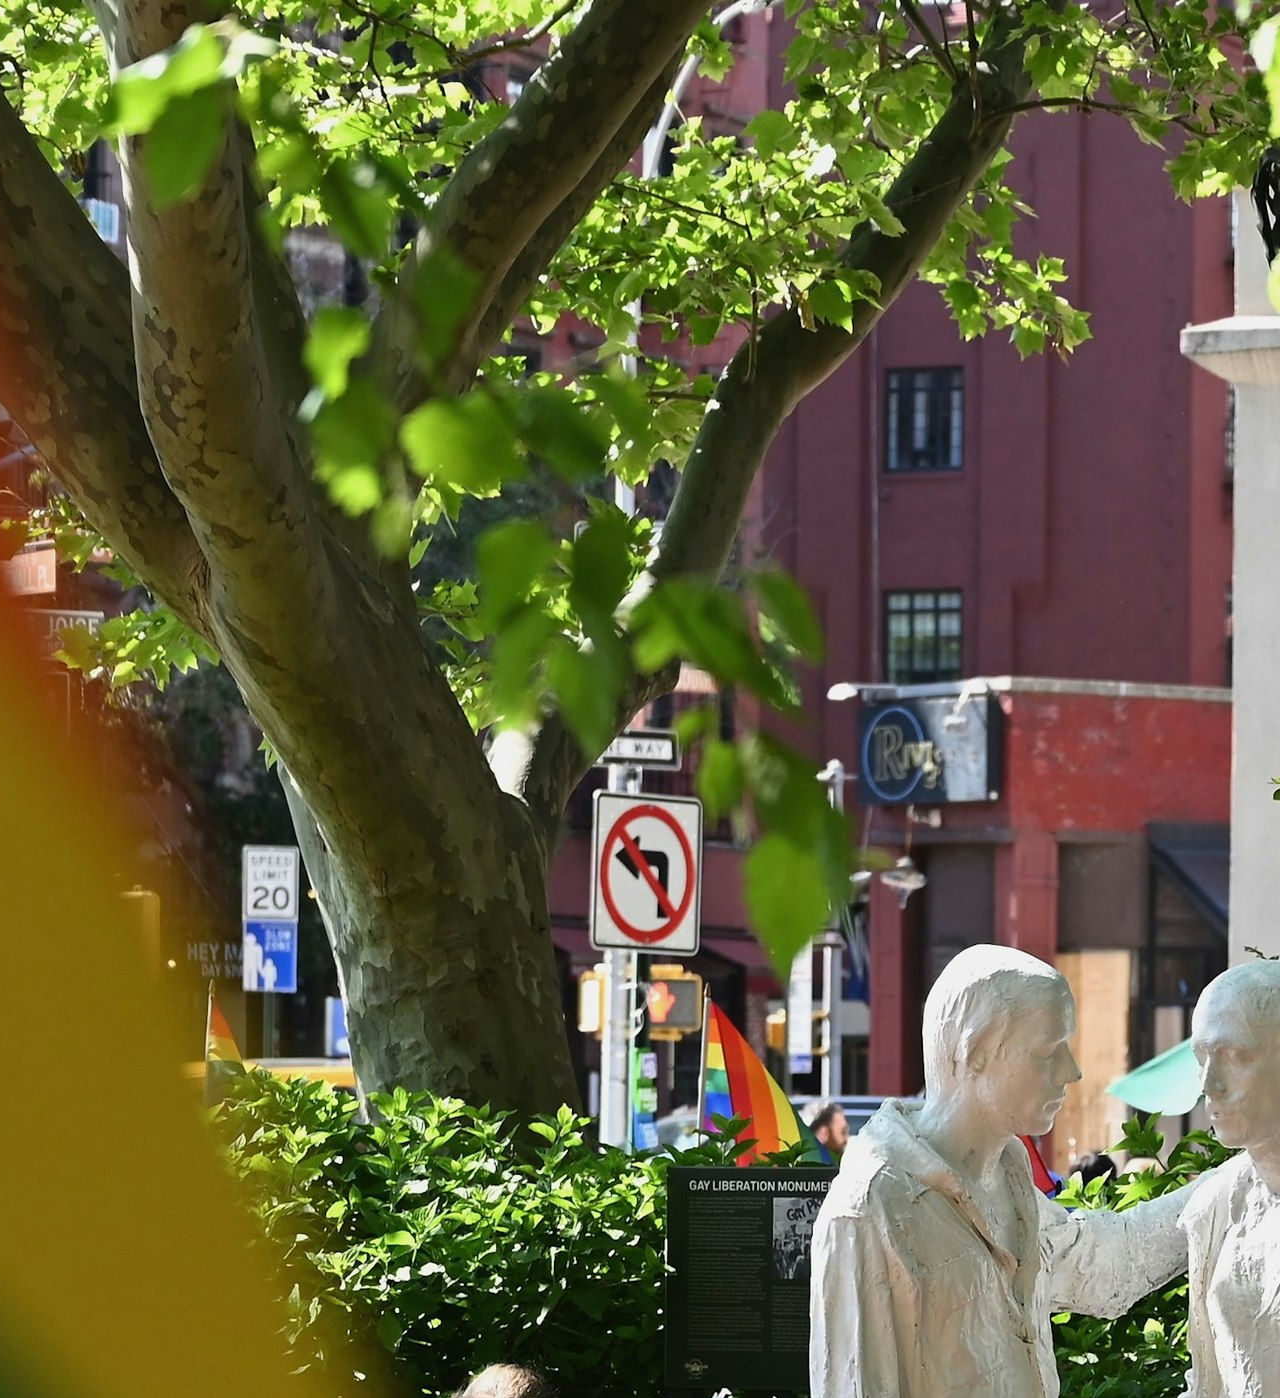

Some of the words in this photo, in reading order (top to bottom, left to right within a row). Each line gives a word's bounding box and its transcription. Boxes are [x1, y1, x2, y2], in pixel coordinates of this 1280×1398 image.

[634, 743, 664, 754] WAY
[251, 856, 292, 866] SPEED
[254, 870, 288, 881] LIMIT
[253, 886, 289, 910] 20
[187, 943, 219, 961] HEY
[201, 963, 221, 977] DAY
[689, 1180, 711, 1191] GAY
[712, 1180, 775, 1191] LIBERATION
[786, 1205, 806, 1221] GAY
